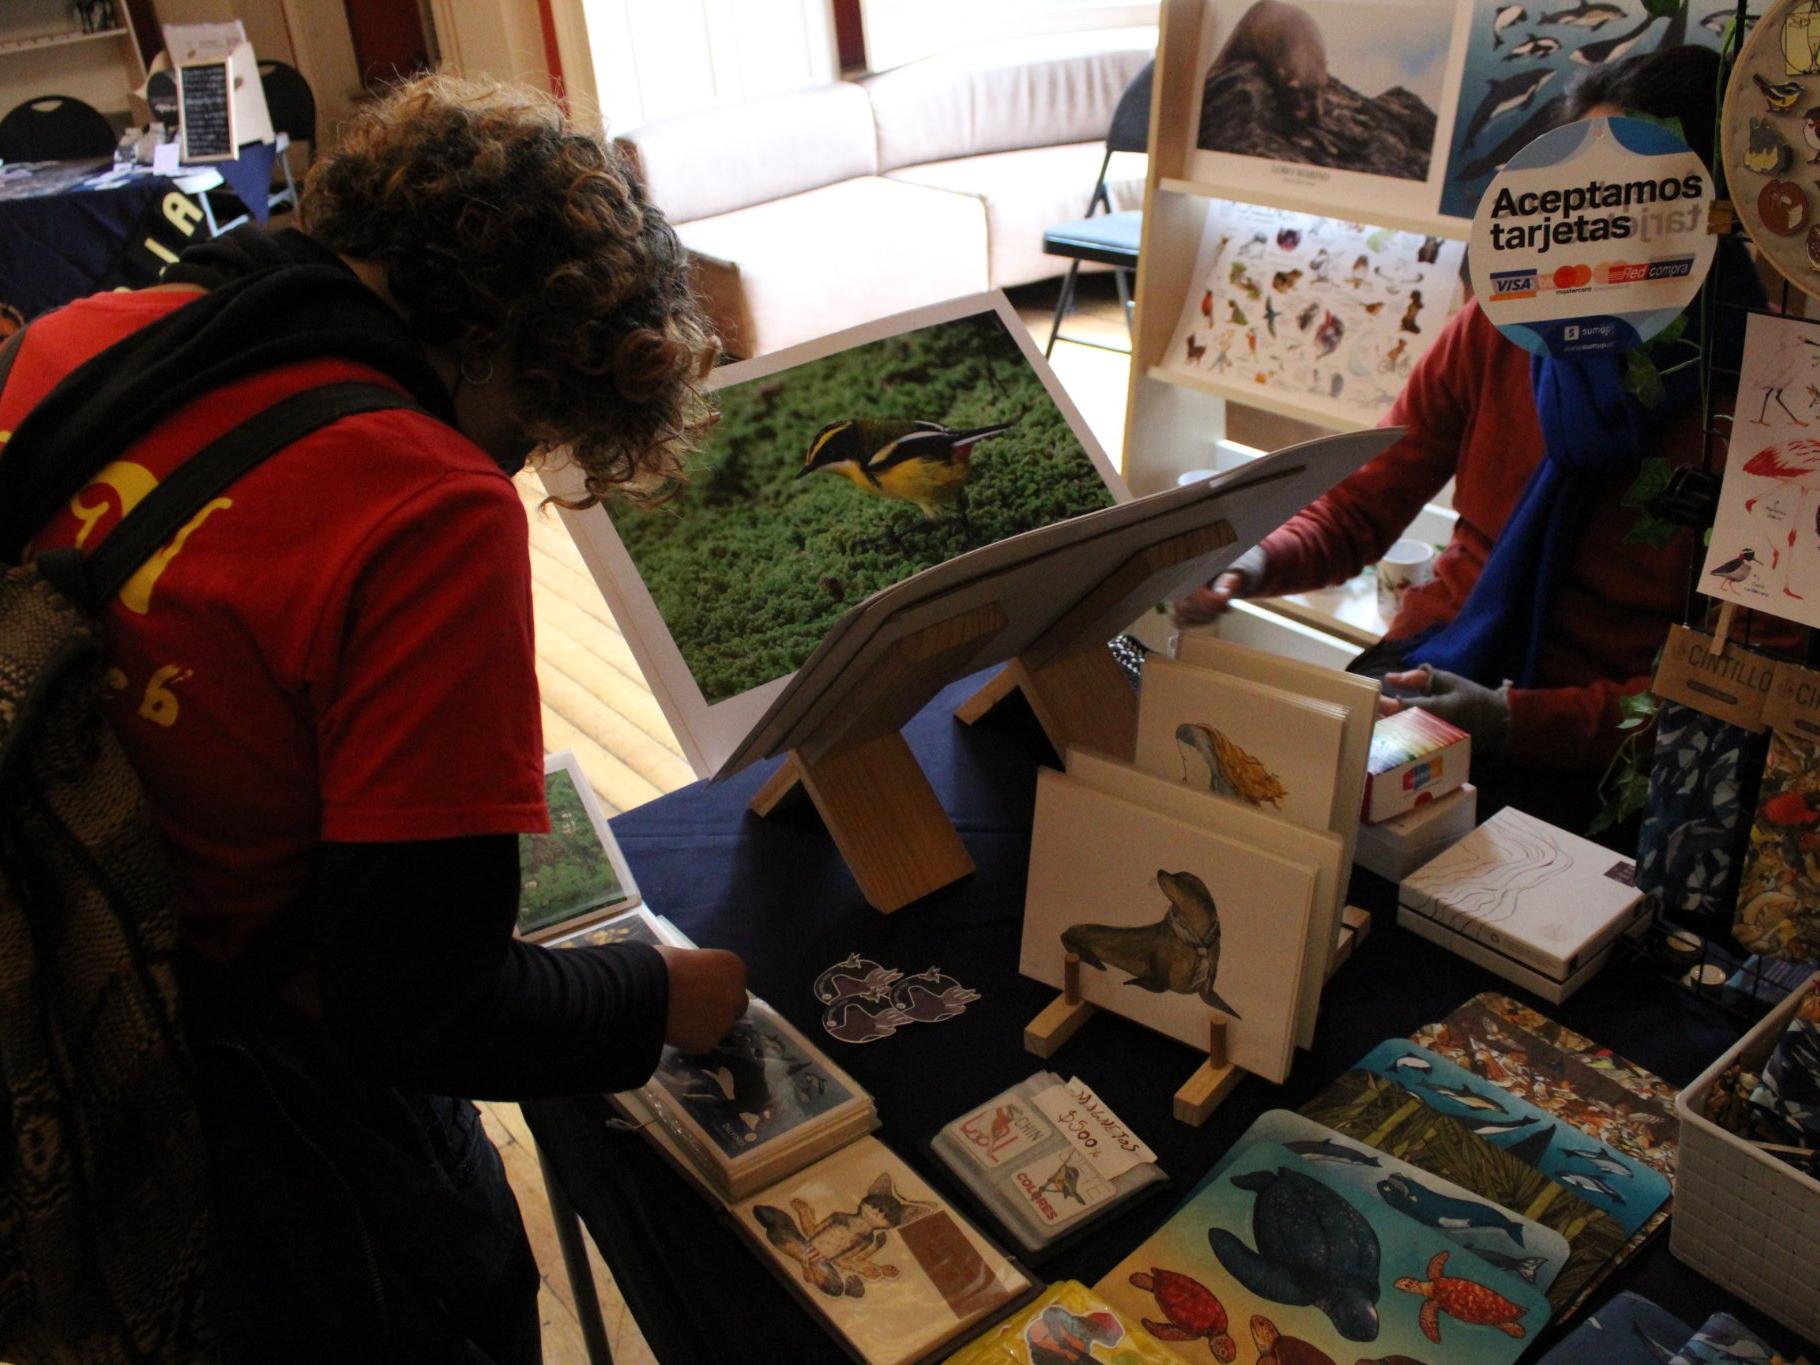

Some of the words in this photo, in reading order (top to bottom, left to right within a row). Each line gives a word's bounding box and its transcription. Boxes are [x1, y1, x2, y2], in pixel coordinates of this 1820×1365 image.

[1490, 174, 1704, 219] Aceptamos
[1490, 215, 1632, 253] tarjetas
[1496, 278, 1532, 293] VISA
[1622, 264, 1647, 281] Red
[1648, 261, 1689, 279] compra
[1688, 645, 1774, 693] CINTILLO
[1017, 1172, 1059, 1221] COLORES
